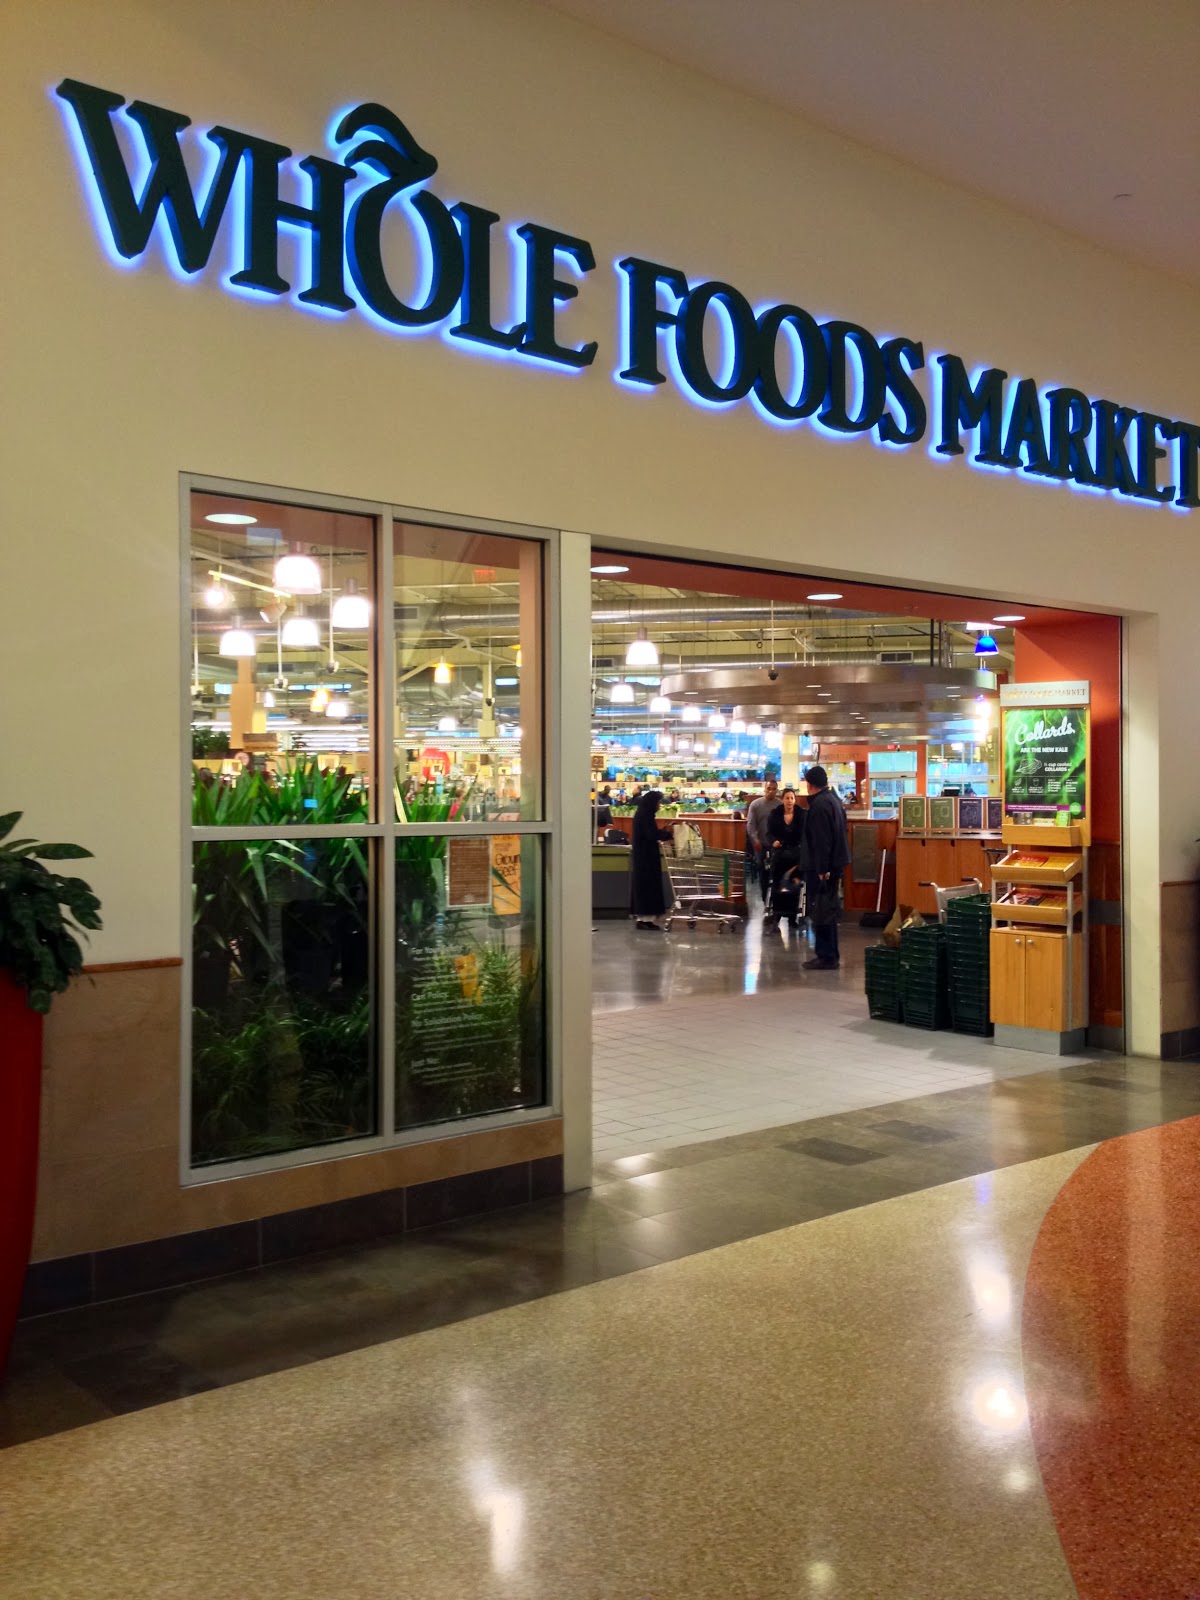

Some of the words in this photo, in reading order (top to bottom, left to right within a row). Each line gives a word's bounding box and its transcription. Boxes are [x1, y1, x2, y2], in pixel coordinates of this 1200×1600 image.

[56, 78, 598, 368] WHOLE
[619, 257, 927, 444] FOODS
[937, 354, 1200, 509] MARKET
[1015, 716, 1075, 745] Collards
